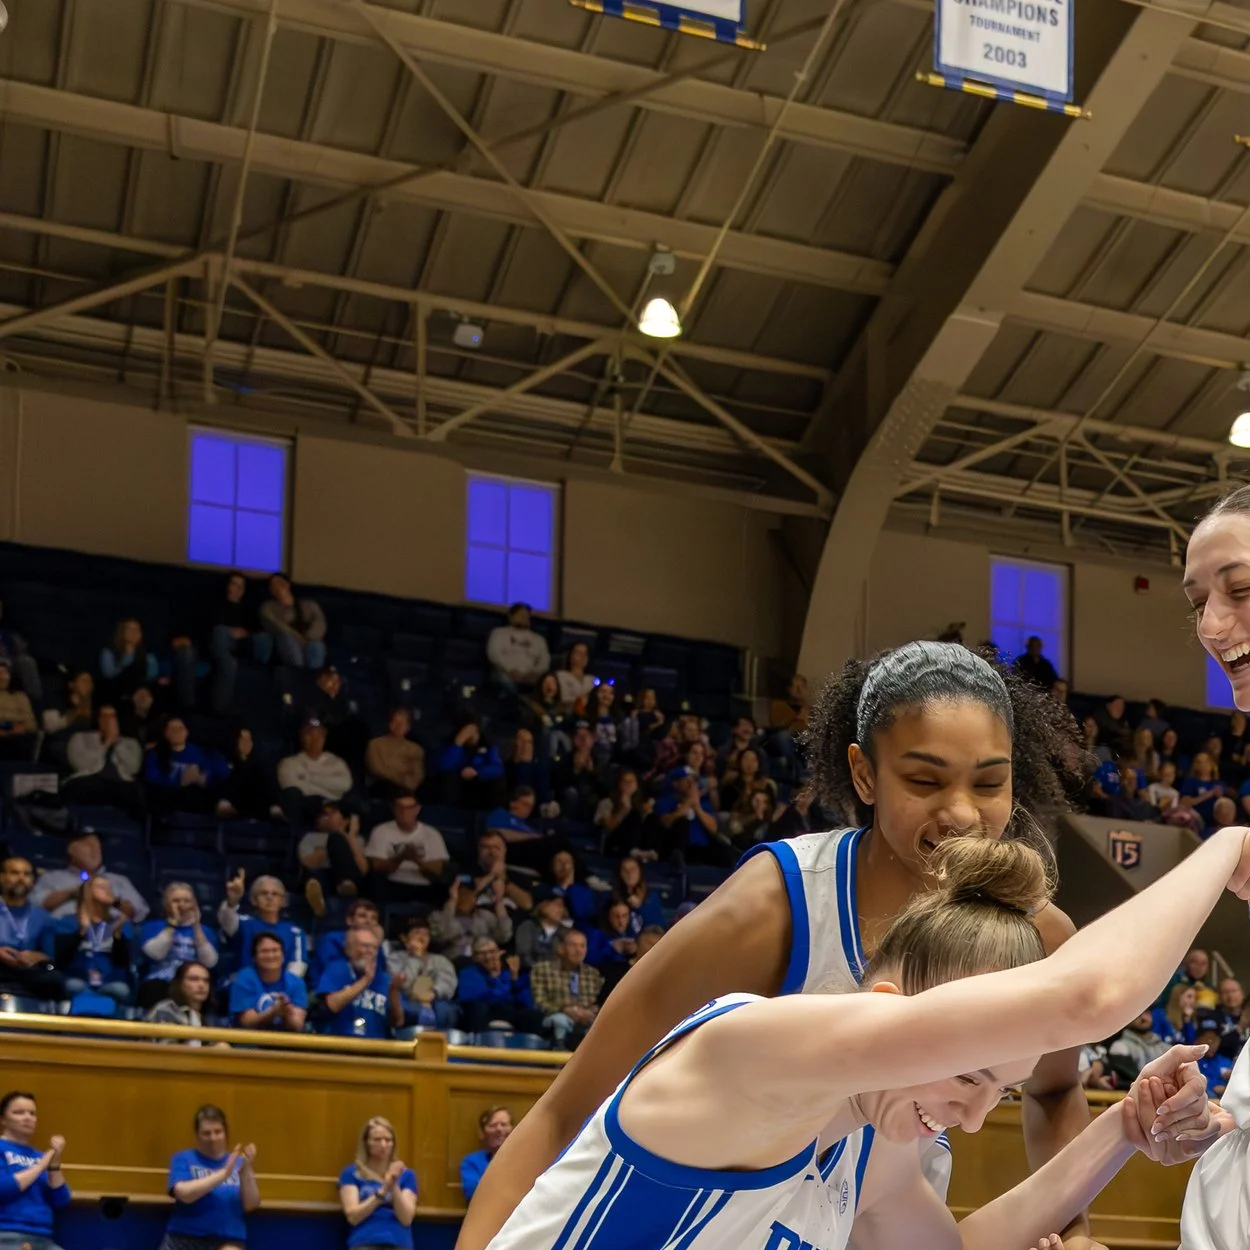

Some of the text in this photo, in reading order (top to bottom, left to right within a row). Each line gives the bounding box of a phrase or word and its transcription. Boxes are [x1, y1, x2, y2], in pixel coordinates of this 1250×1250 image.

[969, 15, 1041, 43] TOURNAMENT
[983, 43, 1027, 69] 2003
[1115, 842, 1139, 866] 15
